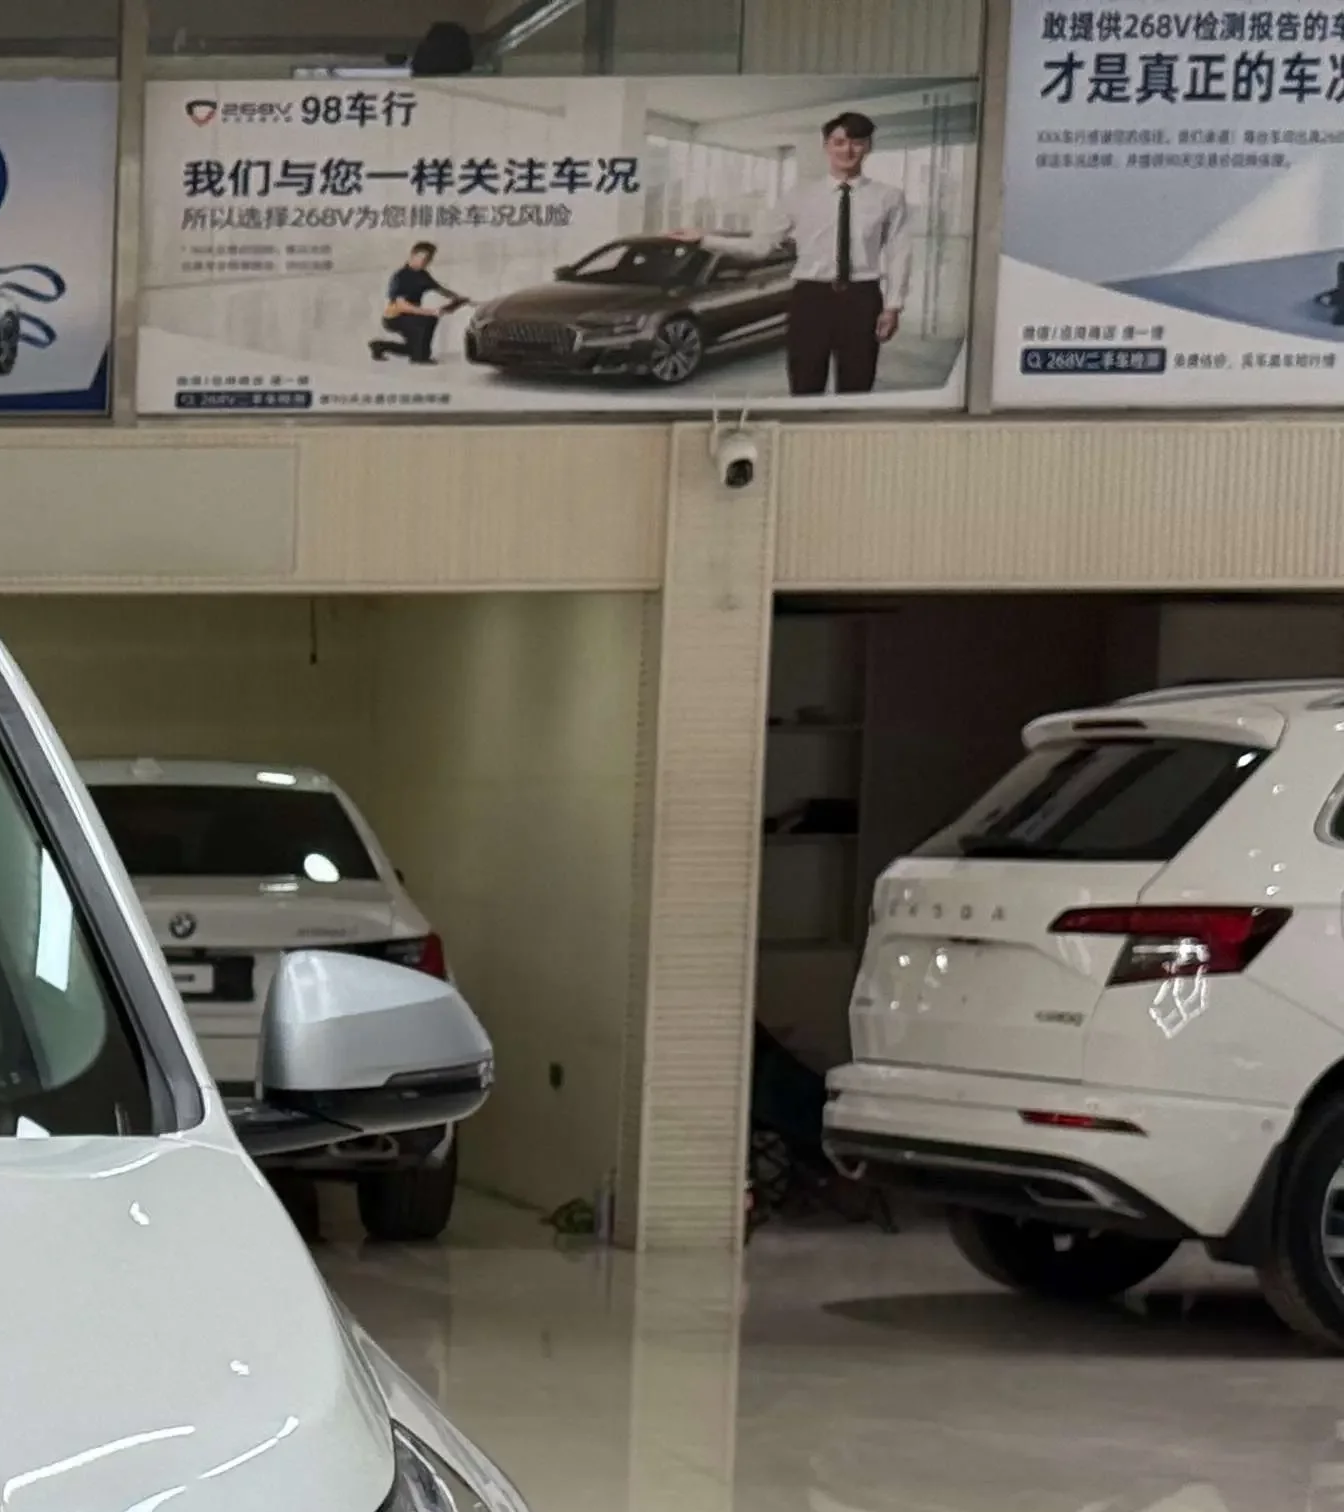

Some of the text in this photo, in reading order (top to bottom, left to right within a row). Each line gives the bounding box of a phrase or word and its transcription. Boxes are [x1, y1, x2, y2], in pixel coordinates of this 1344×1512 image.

[301, 90, 417, 127] 98车行
[183, 157, 639, 196] 我们与您一样关注车况
[181, 203, 572, 230] 所以选择268V为您排除车况风险
